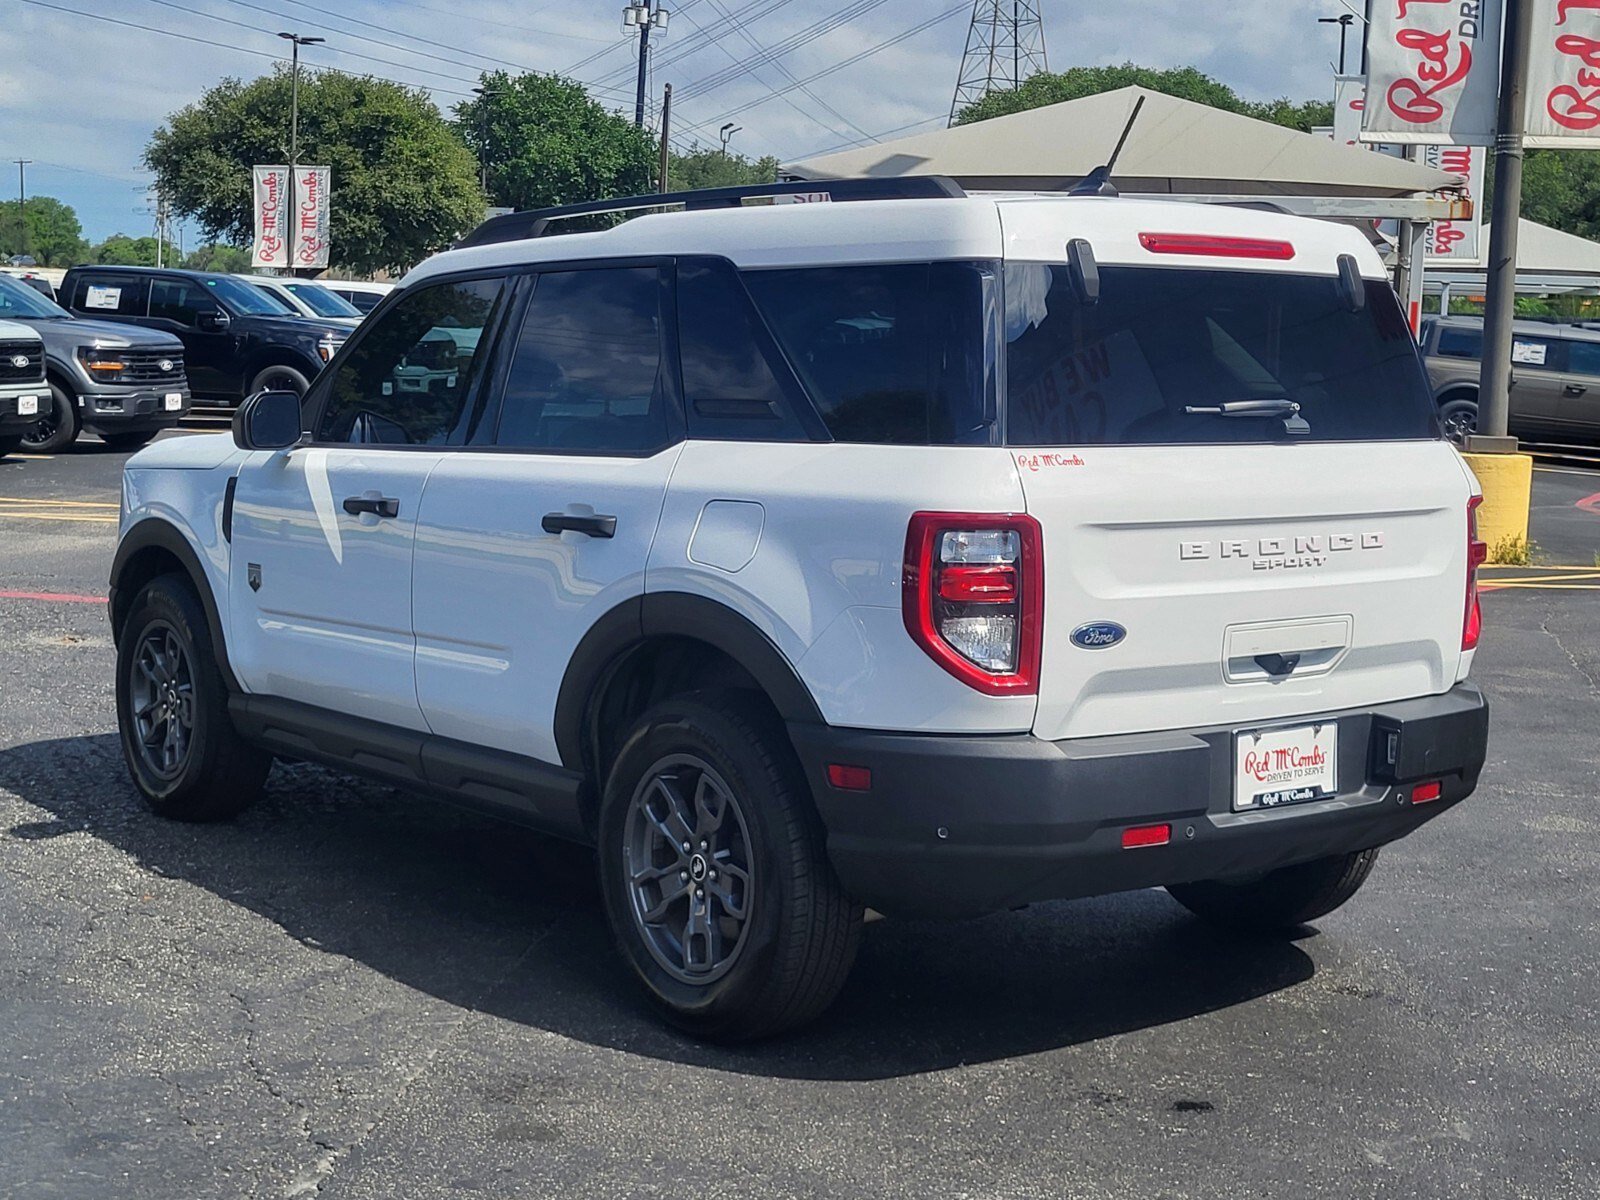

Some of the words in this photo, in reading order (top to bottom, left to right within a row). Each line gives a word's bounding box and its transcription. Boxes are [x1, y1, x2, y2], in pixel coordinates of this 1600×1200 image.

[1387, 29, 1473, 123] Red
[259, 235, 281, 262] Red
[299, 235, 321, 262] Red
[1018, 455, 1039, 472] Red
[1179, 531, 1384, 560] BRONCO
[1253, 557, 1327, 570] SPORT
[1084, 628, 1116, 644] Ford
[1245, 750, 1269, 781] Red
[1267, 771, 1292, 782] DRIVEN
[1294, 769, 1304, 779] TO
[1304, 766, 1325, 776] SERVE
[1262, 793, 1280, 806] Red
